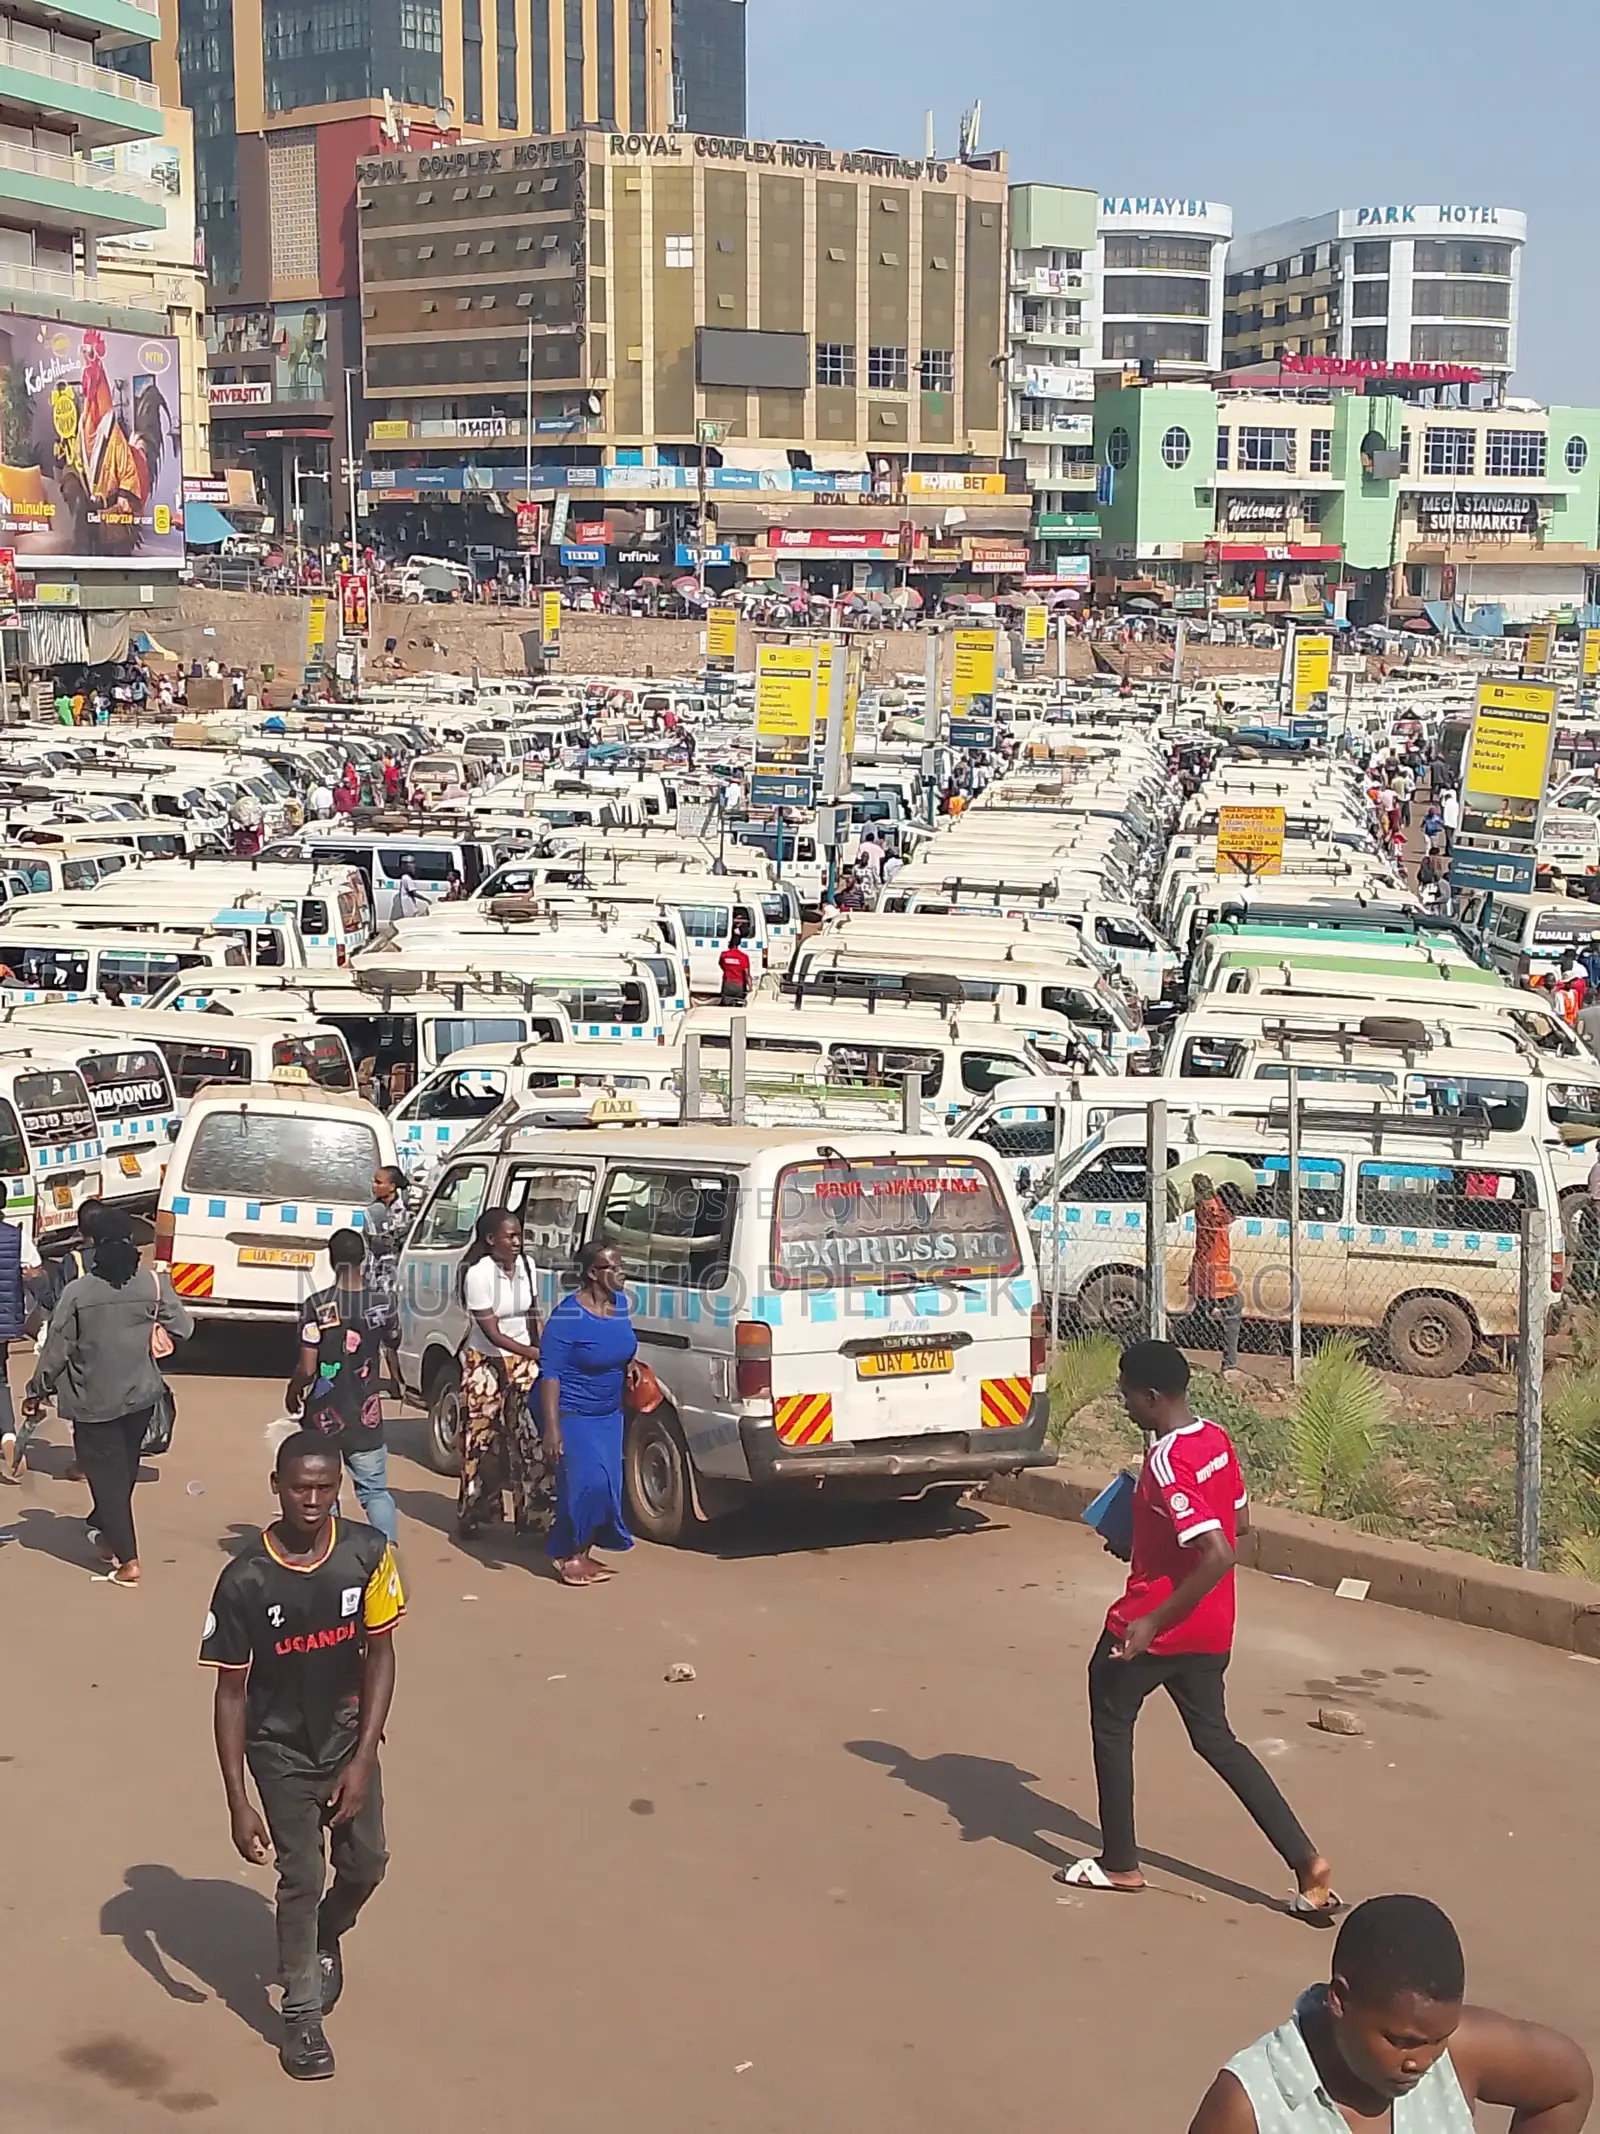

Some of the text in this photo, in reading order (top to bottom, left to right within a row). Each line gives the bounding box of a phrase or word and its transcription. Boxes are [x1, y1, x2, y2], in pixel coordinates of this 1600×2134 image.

[419, 149, 502, 174] COMPLEX
[513, 140, 574, 165] HOTEL
[610, 134, 683, 156] ROYAL
[695, 136, 776, 165] COMPLEX
[781, 147, 836, 171] HOTEL
[1103, 197, 1499, 226] NAMAYIBA PARK HOTEL
[209, 387, 265, 403] NIVERSITY
[814, 492, 848, 505] ROYAL
[1421, 496, 1531, 513] MEGA STANDARD
[13, 500, 56, 517] minutes
[1228, 497, 1283, 521] Welcome
[1430, 514, 1524, 531] SUPERMARKET
[1264, 546, 1292, 560] TCL
[278, 1067, 303, 1078] TAXI
[601, 1100, 633, 1114] TAXI
[782, 1232, 958, 1268] EXPRESS
[876, 1349, 948, 1372] UAY 167H
